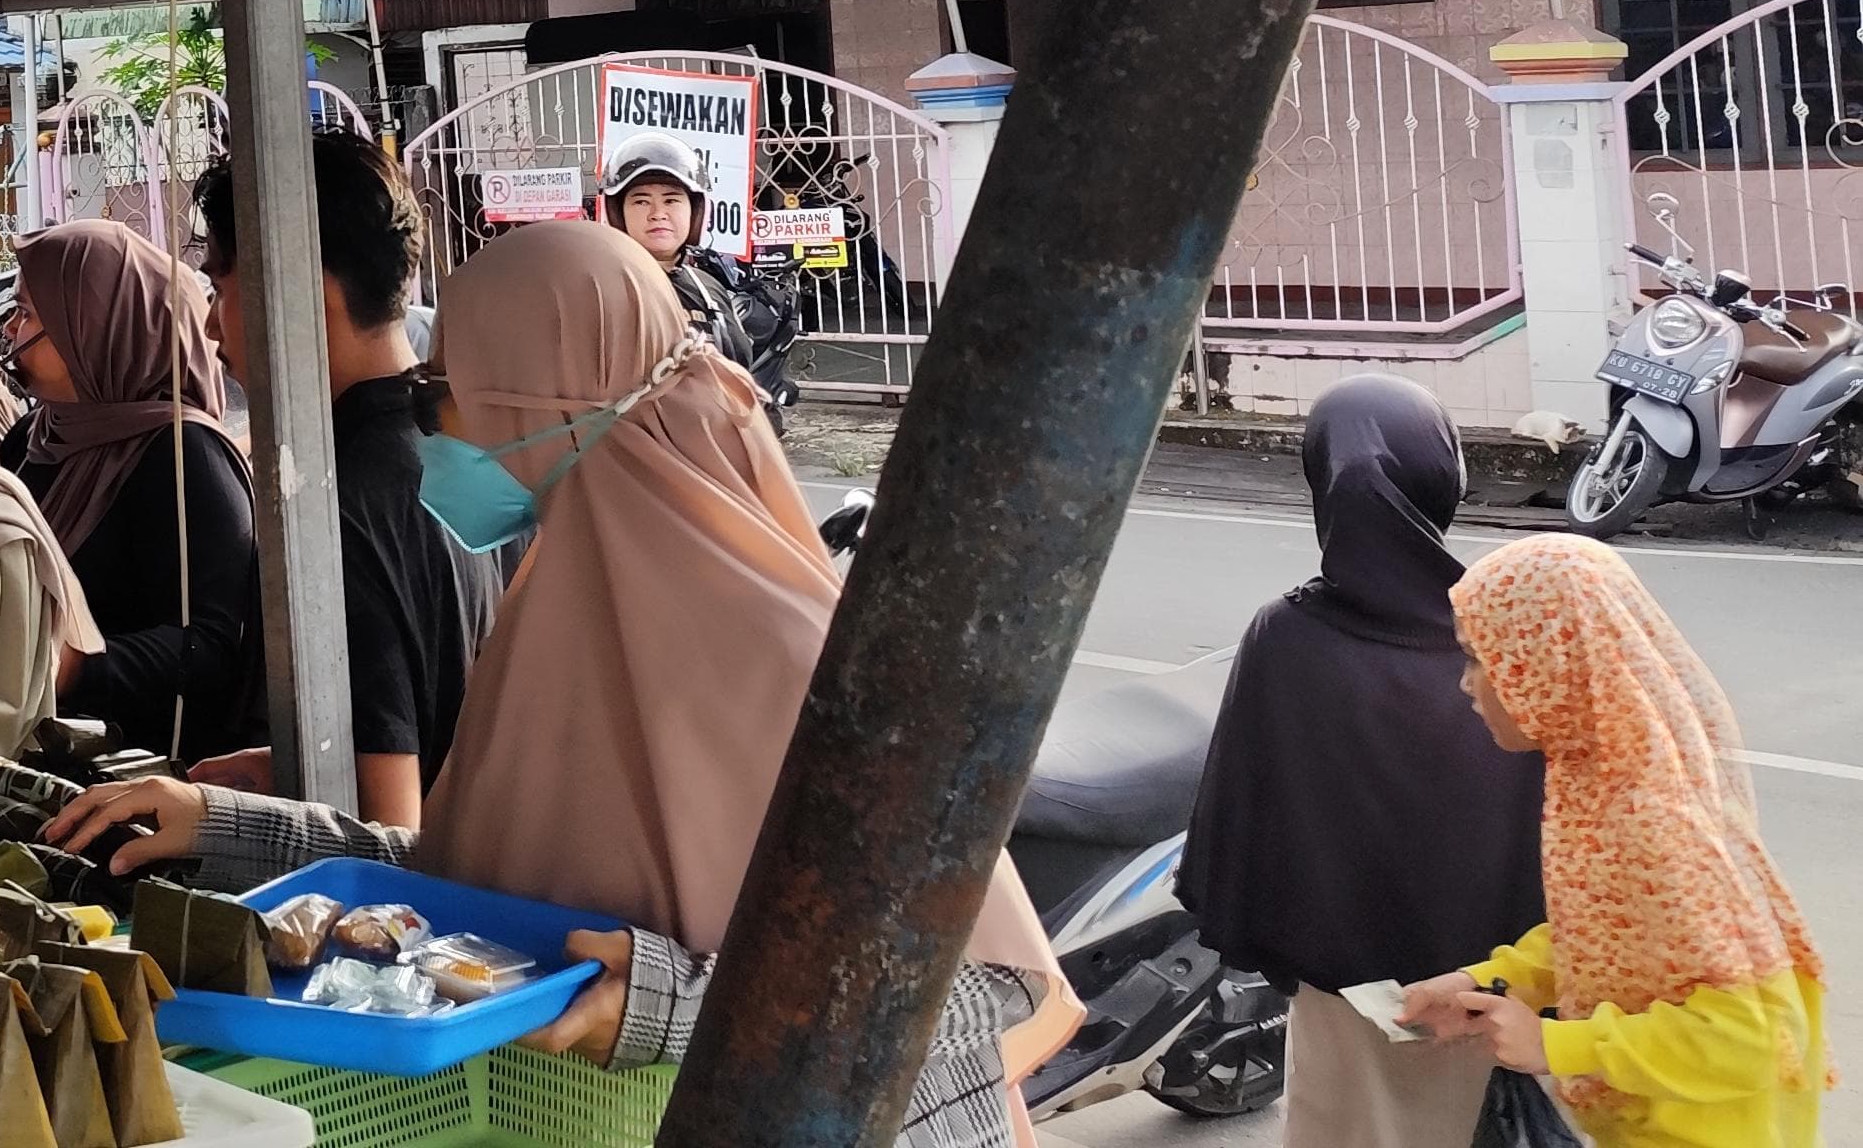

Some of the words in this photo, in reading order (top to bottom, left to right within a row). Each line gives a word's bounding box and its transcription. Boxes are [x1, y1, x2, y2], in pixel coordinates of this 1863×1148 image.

[610, 86, 746, 136] DISEWAKAN
[513, 174, 546, 187] DILARANG
[547, 172, 572, 186] PARKIR
[774, 213, 830, 224] DILARANG
[775, 223, 831, 236] PARKIR
